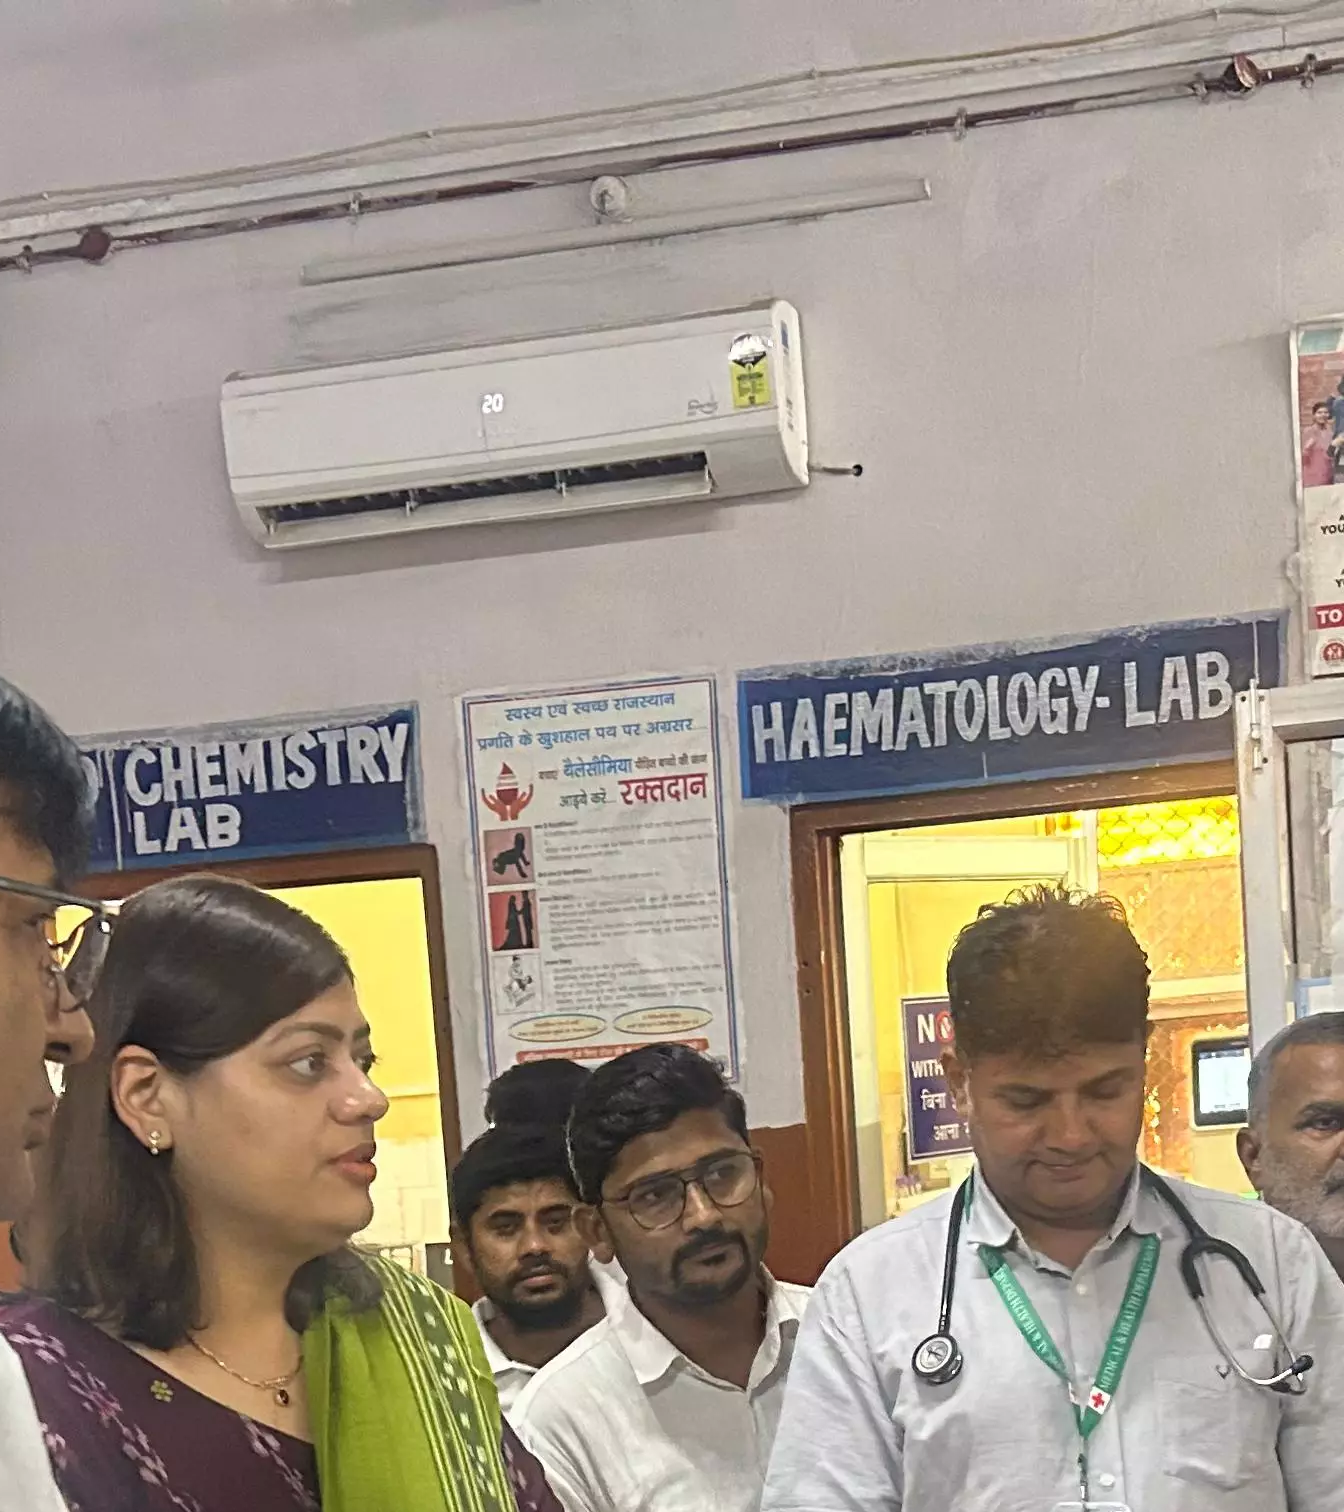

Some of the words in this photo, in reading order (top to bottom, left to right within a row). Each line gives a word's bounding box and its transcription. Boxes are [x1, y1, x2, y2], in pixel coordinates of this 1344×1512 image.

[482, 393, 504, 414] 20
[1317, 609, 1342, 625] TO
[1124, 651, 1236, 730] LAB
[623, 722, 641, 736] पर
[124, 723, 409, 806] CHEMISTRY
[618, 773, 708, 805] रक्तदान
[133, 803, 242, 855] LAB
[920, 1088, 947, 1111] बिना
